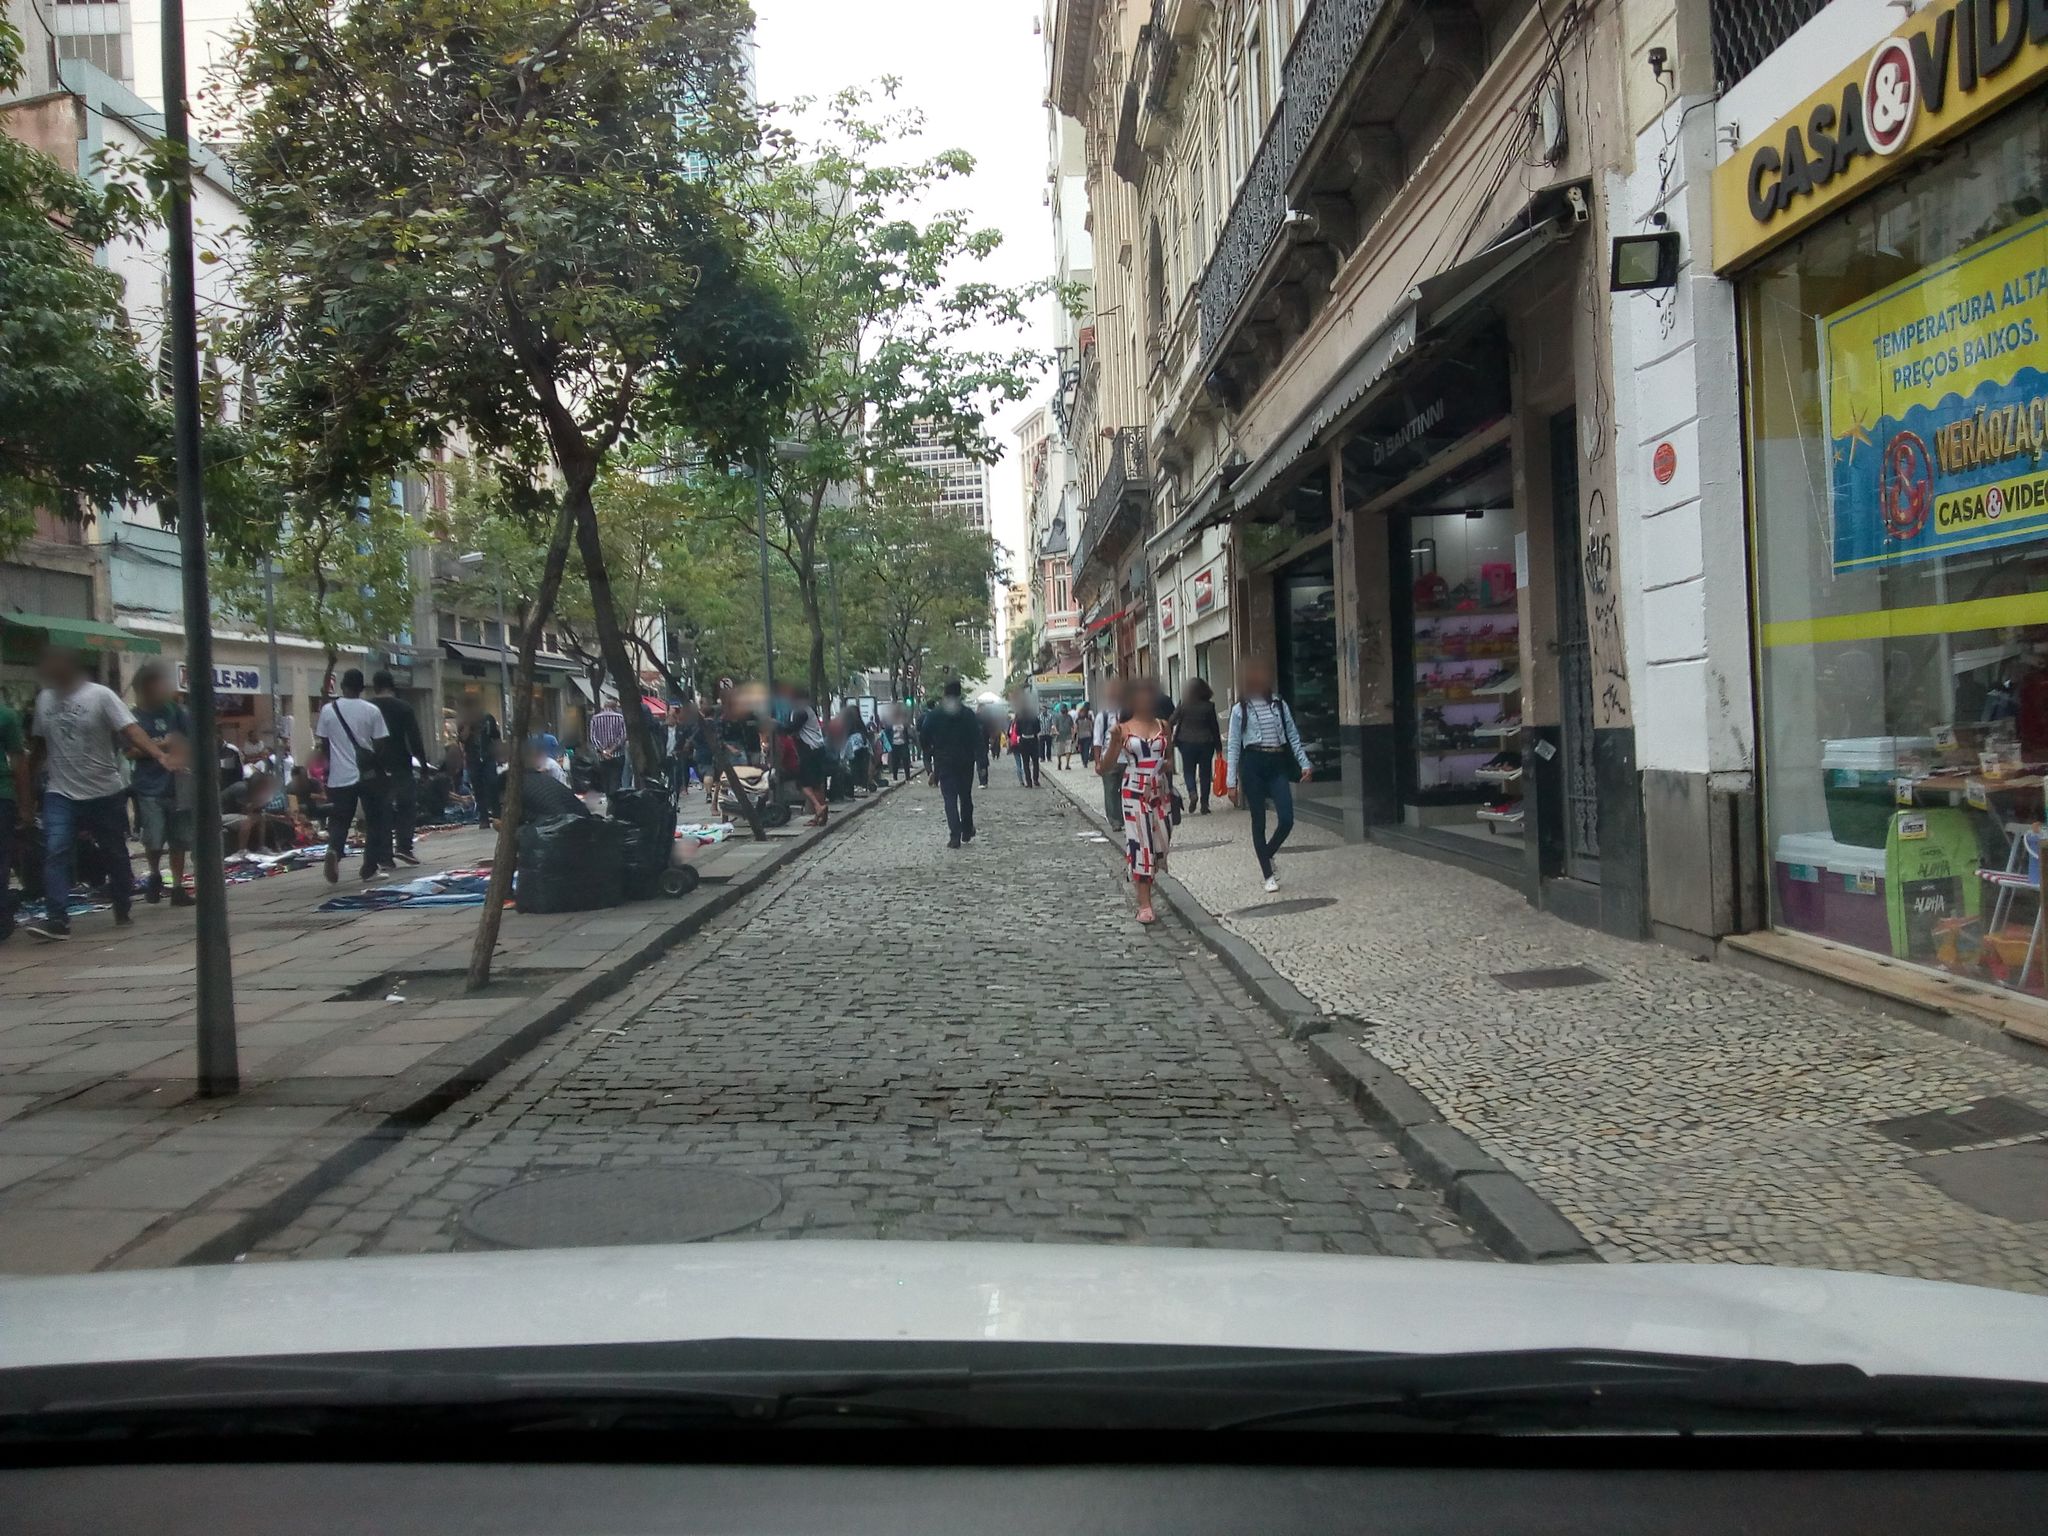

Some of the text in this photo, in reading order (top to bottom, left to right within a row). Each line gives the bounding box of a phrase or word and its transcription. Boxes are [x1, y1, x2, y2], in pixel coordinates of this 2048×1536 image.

[1873, 290, 1996, 361] TEMPERATURA
[1893, 317, 2040, 392] PREÇOS BAIXOS.
[1914, 894, 1946, 915] ALOHA
